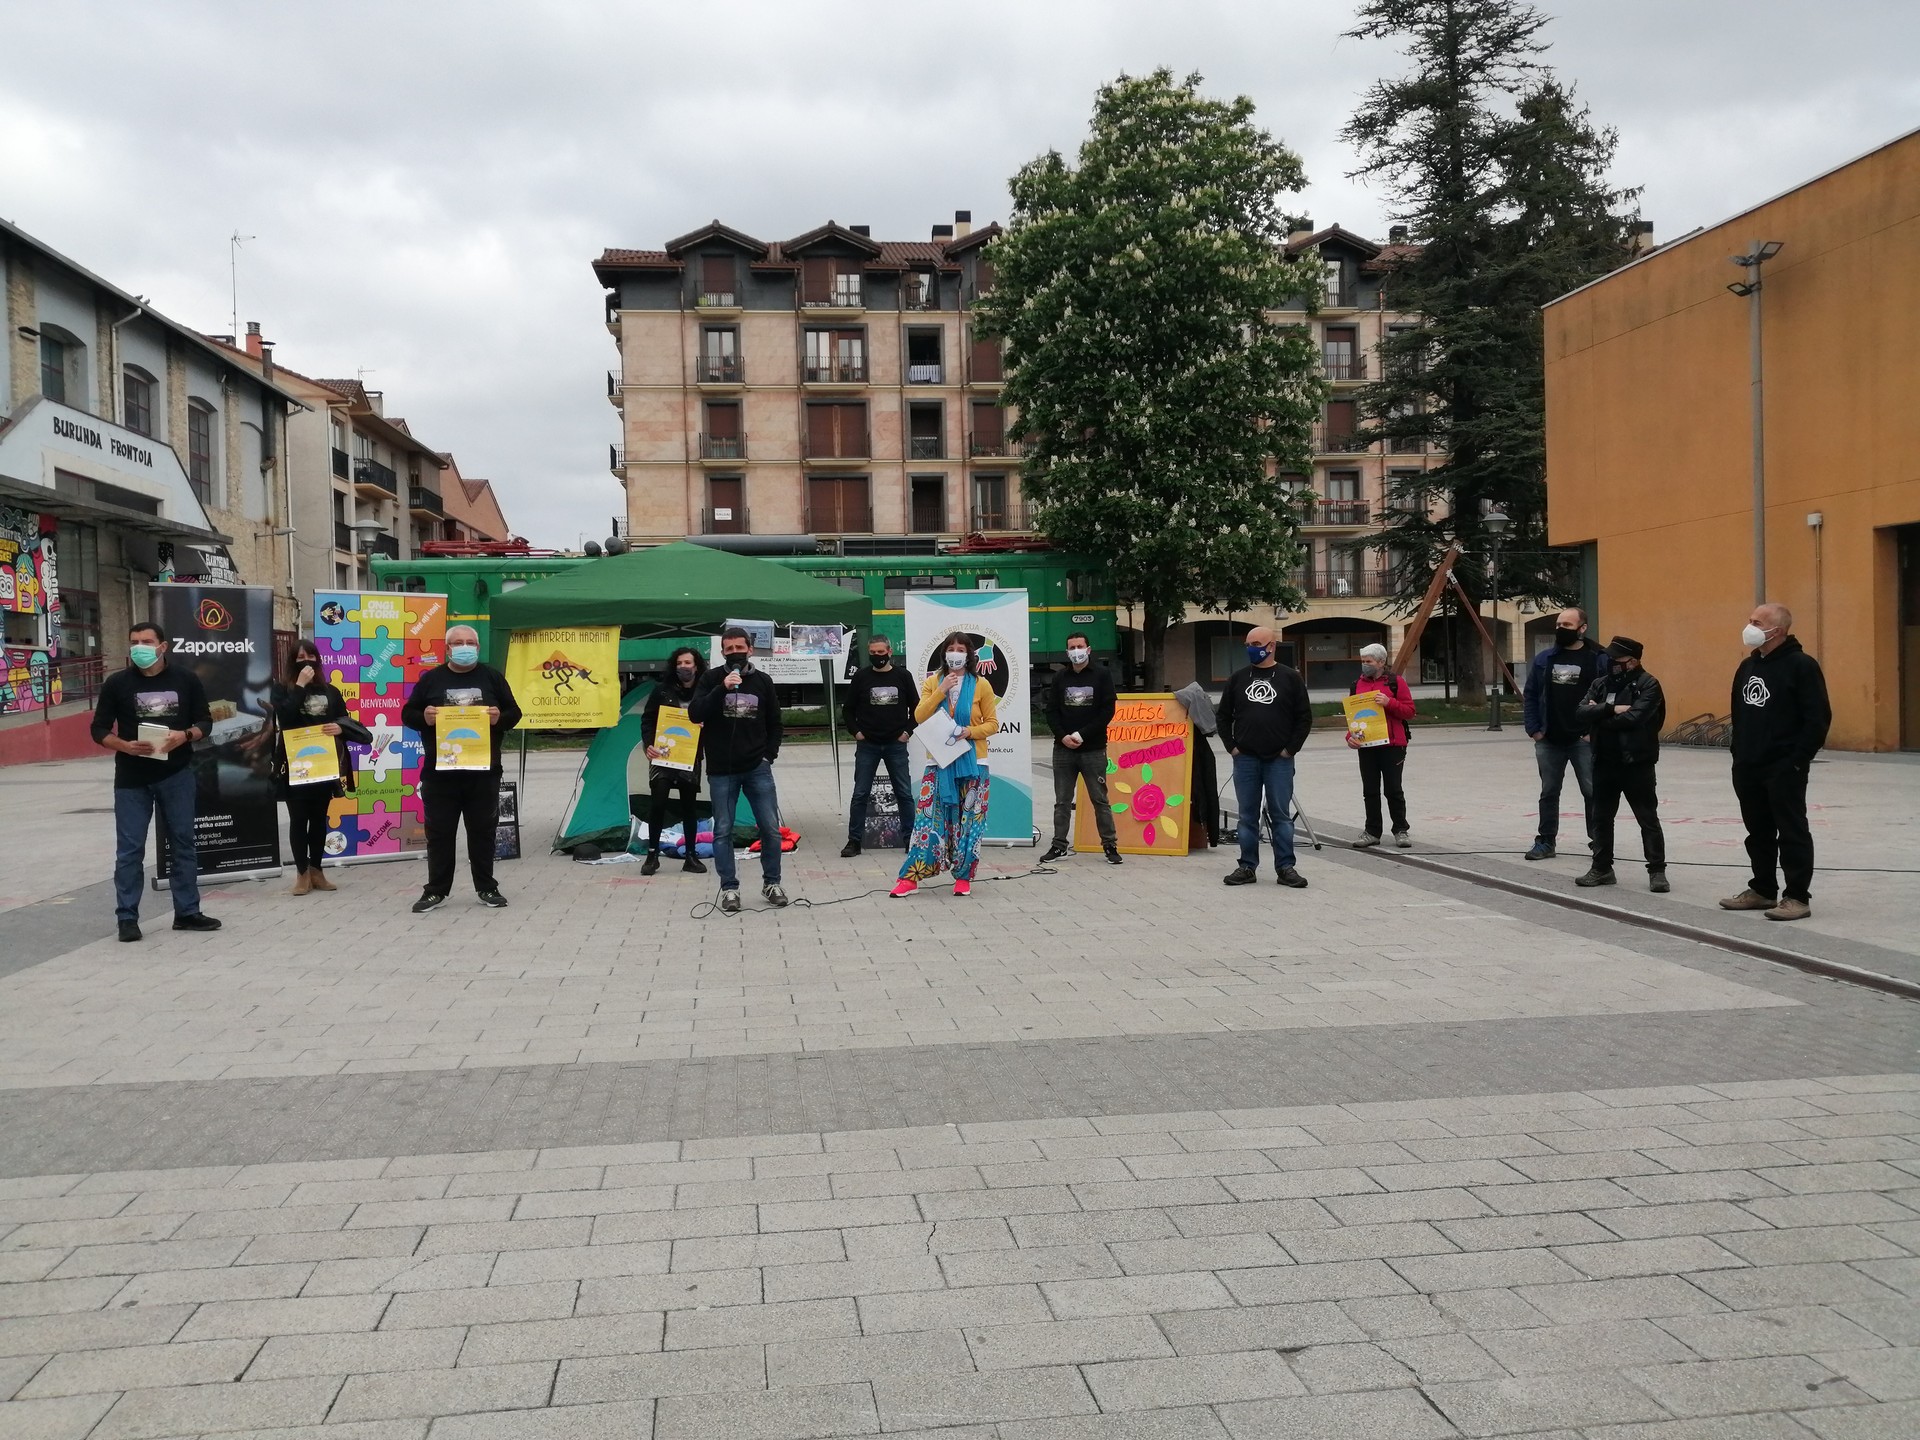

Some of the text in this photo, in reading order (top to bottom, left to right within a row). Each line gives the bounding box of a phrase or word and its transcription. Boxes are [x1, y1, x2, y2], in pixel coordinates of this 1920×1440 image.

[53, 416, 153, 467] BURUNDA FRONTOIA
[367, 600, 394, 610] ONGI
[362, 609, 399, 620] ETORRI
[510, 631, 610, 643] SAKANA HARRERA HARANA
[940, 624, 980, 639] ZERBITZUA
[172, 637, 255, 656] Zaporeak
[984, 627, 1013, 654] SERVICIO
[360, 698, 400, 709] BIENVENIDAS
[532, 696, 580, 706] ONGI ETORRI
[1115, 703, 1165, 721] autsi
[997, 721, 1021, 734] AN
[356, 787, 404, 796] Добре дошли
[198, 831, 222, 841] dignidad
[366, 819, 393, 848] WELCOME
